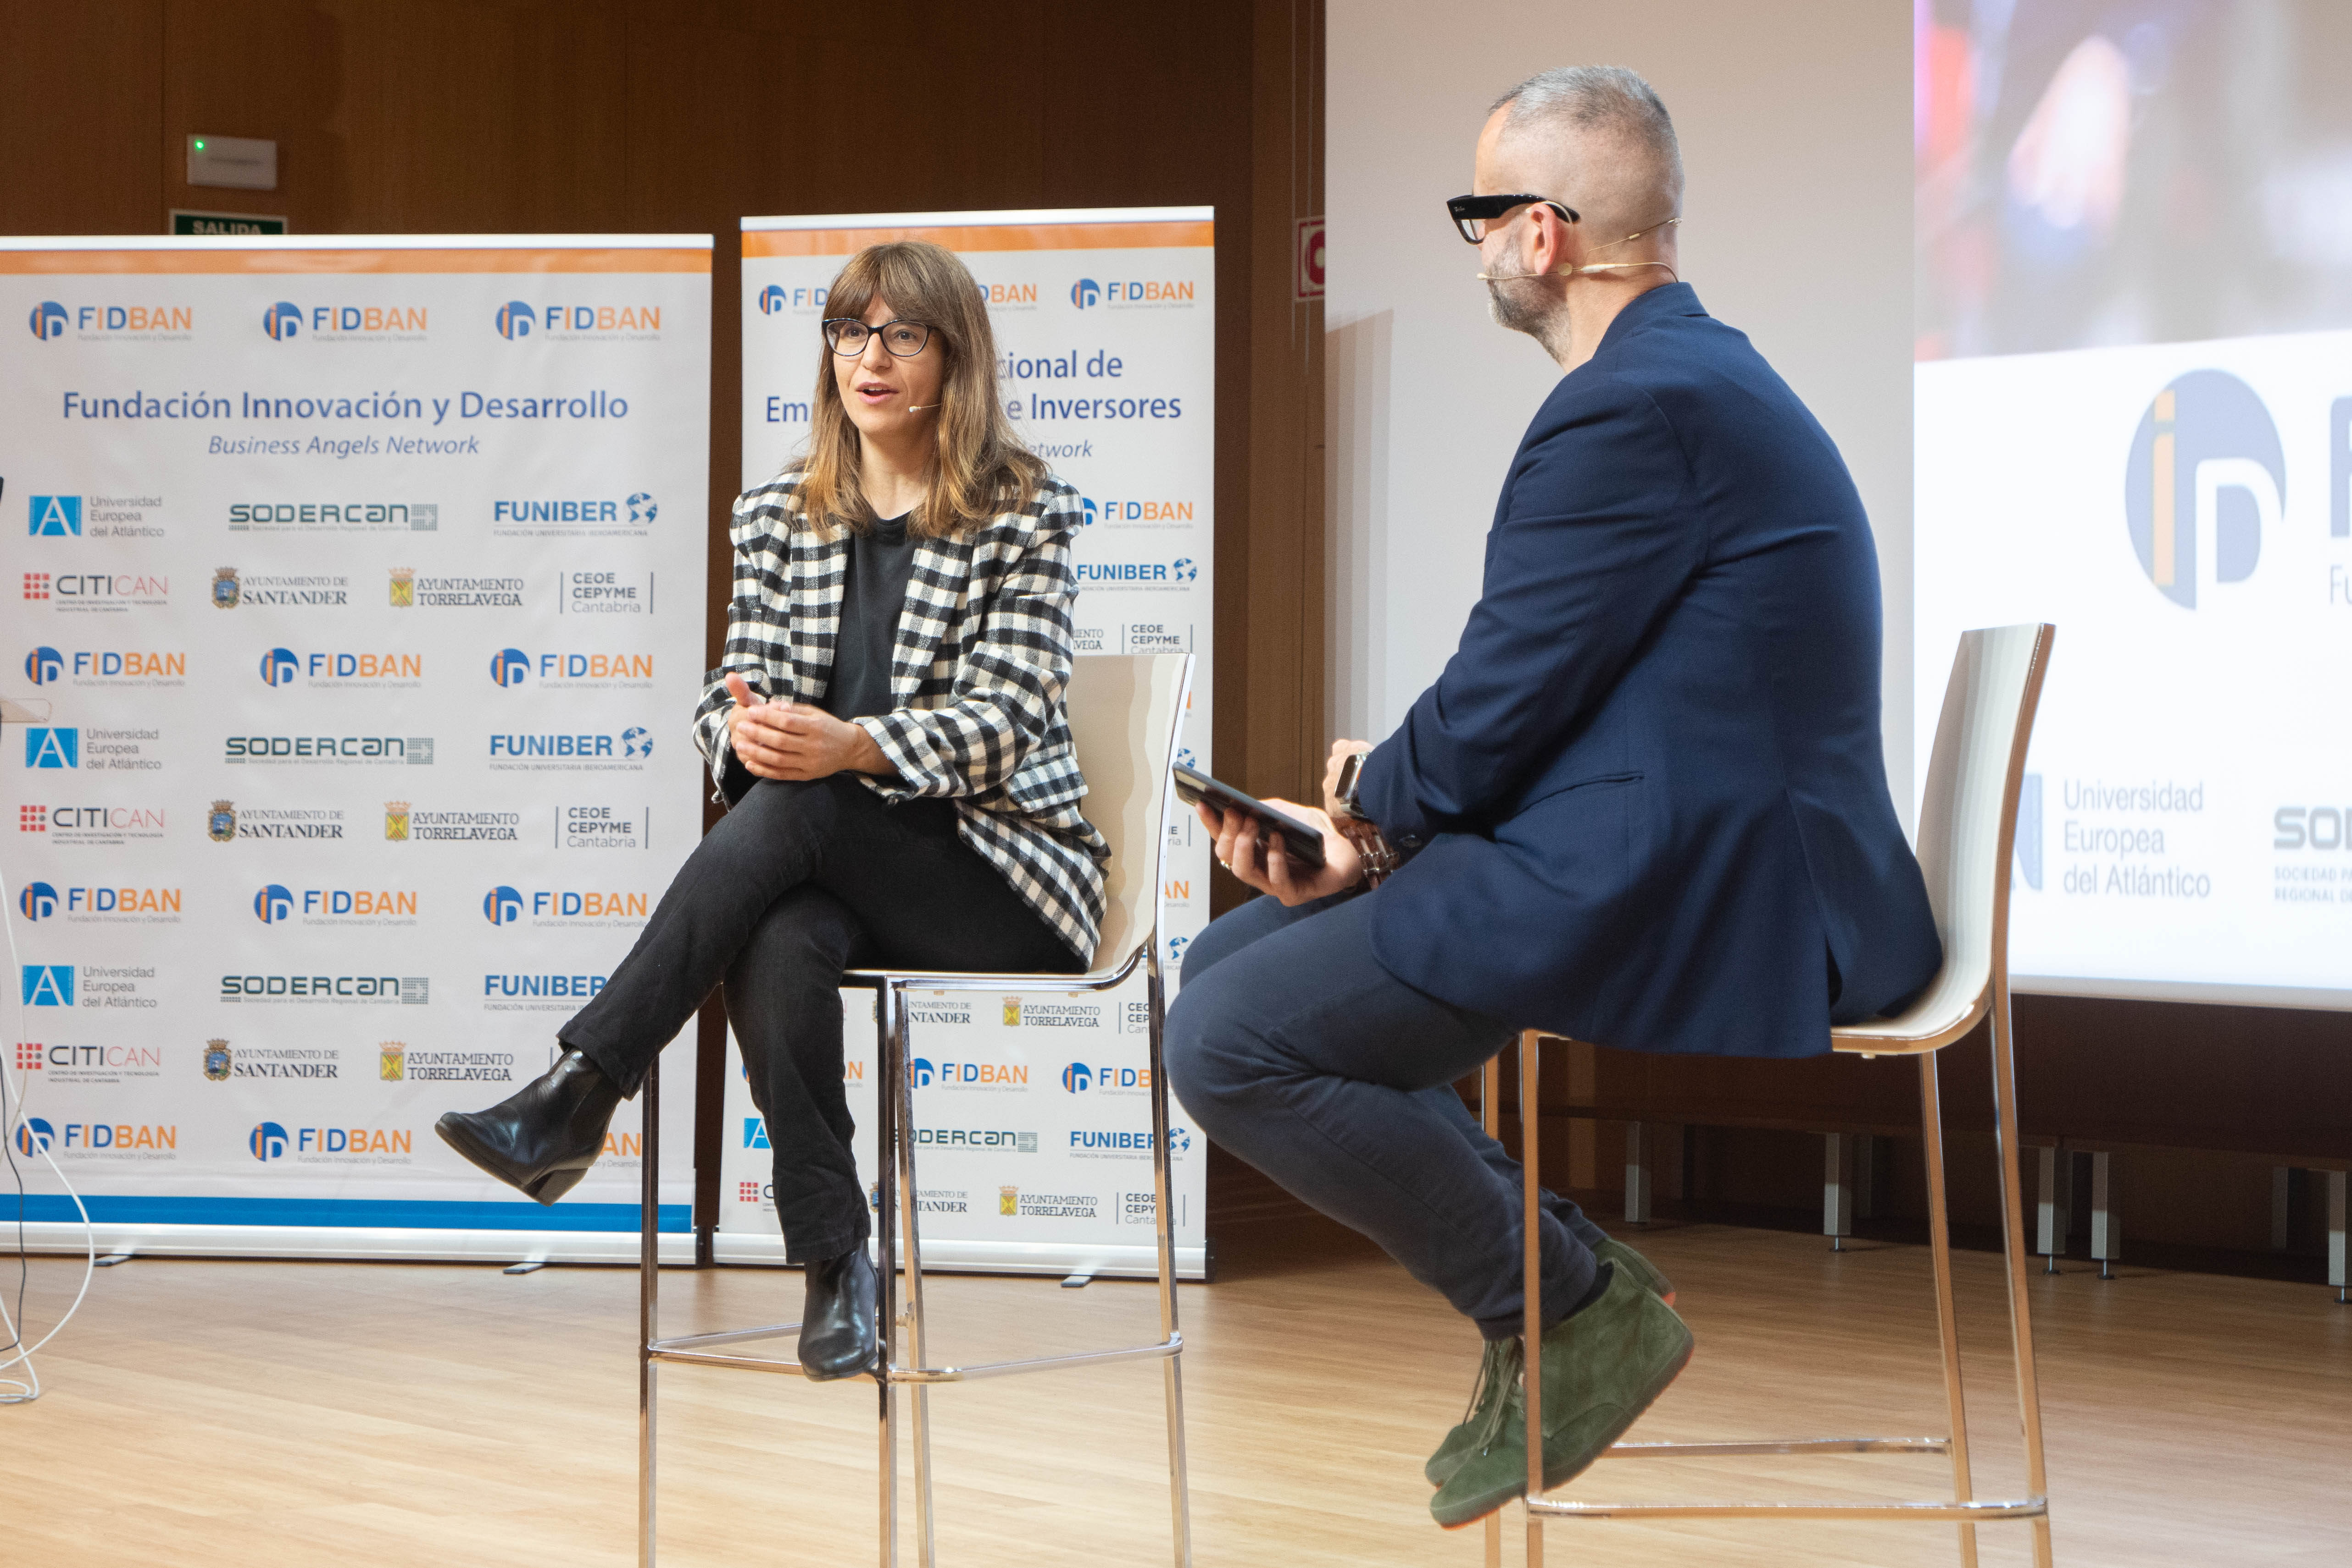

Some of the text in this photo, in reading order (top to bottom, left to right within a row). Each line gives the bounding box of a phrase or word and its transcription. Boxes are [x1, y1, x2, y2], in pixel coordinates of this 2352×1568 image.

[1108, 282, 1193, 300] FIDBAN
[79, 306, 191, 330] FIDBAN
[313, 307, 426, 330] FIDBAN
[546, 306, 660, 330] FIDBAN
[1087, 349, 1122, 377] de
[64, 390, 628, 425] Fundación Innovación y Desarrollo
[1032, 393, 1181, 419] Inversores
[209, 435, 478, 459] Business Angels Network
[90, 496, 162, 507] Universidad
[90, 509, 142, 523] Europea
[495, 501, 616, 521] FUNIBER
[1106, 502, 1192, 520] FIDBAN
[90, 526, 164, 537] del Atlántico
[573, 573, 615, 584] CEOE
[1077, 564, 1167, 580] FUNIBER
[56, 575, 166, 595] CITICAN
[243, 576, 348, 586] AYUNTAMIENTO DE
[417, 578, 523, 591] AYUNTAMIENTO
[243, 591, 346, 604] SANTANDER
[418, 593, 522, 606] TORRELAVEGA
[573, 587, 636, 598] CEPYME
[572, 601, 641, 613] Cantabria
[1131, 624, 1163, 633] CEOE
[1132, 636, 1179, 645] CEPYME
[74, 652, 184, 675] FIDBAN
[309, 654, 420, 677] FIDBAN
[541, 654, 652, 678] FIDBAN
[87, 728, 159, 740] Universidad
[87, 742, 139, 756] Europea
[490, 735, 612, 756] FUNIBER
[86, 758, 161, 769] del Atlántico
[2064, 779, 2203, 812] Universidad
[53, 807, 162, 828] CITICAN
[239, 810, 344, 820] AYUNTAMIENTO DE
[413, 812, 519, 824] AYUNTAMIENTO
[568, 807, 610, 819] CEOE
[239, 824, 342, 838] SANTANDER
[414, 827, 517, 840] TORRELAVEGA
[568, 822, 631, 833] CEPYME
[567, 835, 636, 847] Cantabria
[2064, 820, 2165, 861] Europea
[2063, 864, 2211, 898] del Atlántico
[69, 888, 180, 912] FIDBAN
[305, 890, 416, 914] FIDBAN
[534, 892, 647, 916] FIDBAN
[83, 966, 155, 978] Universidad
[83, 980, 135, 995] Europea
[83, 996, 157, 1007] del Atlántico
[1023, 1005, 1100, 1017] AYUNTAMIENTO
[1023, 1016, 1099, 1027] TORRELAVEGA
[49, 1045, 158, 1066] CITICAN
[234, 1049, 339, 1060] AYUNTAMIENTO DE
[408, 1052, 513, 1065] AYUNTAMIENTO
[234, 1063, 337, 1078] SANTANDER
[408, 1068, 512, 1081] TORRELAVEGA
[942, 1063, 1027, 1083] FIDBAN
[65, 1124, 175, 1149] FIDBAN
[299, 1129, 410, 1153] FIDBAN
[1020, 1195, 1097, 1207] AYUNTAMIENTO
[1020, 1206, 1096, 1218] TORRELAVEGA
